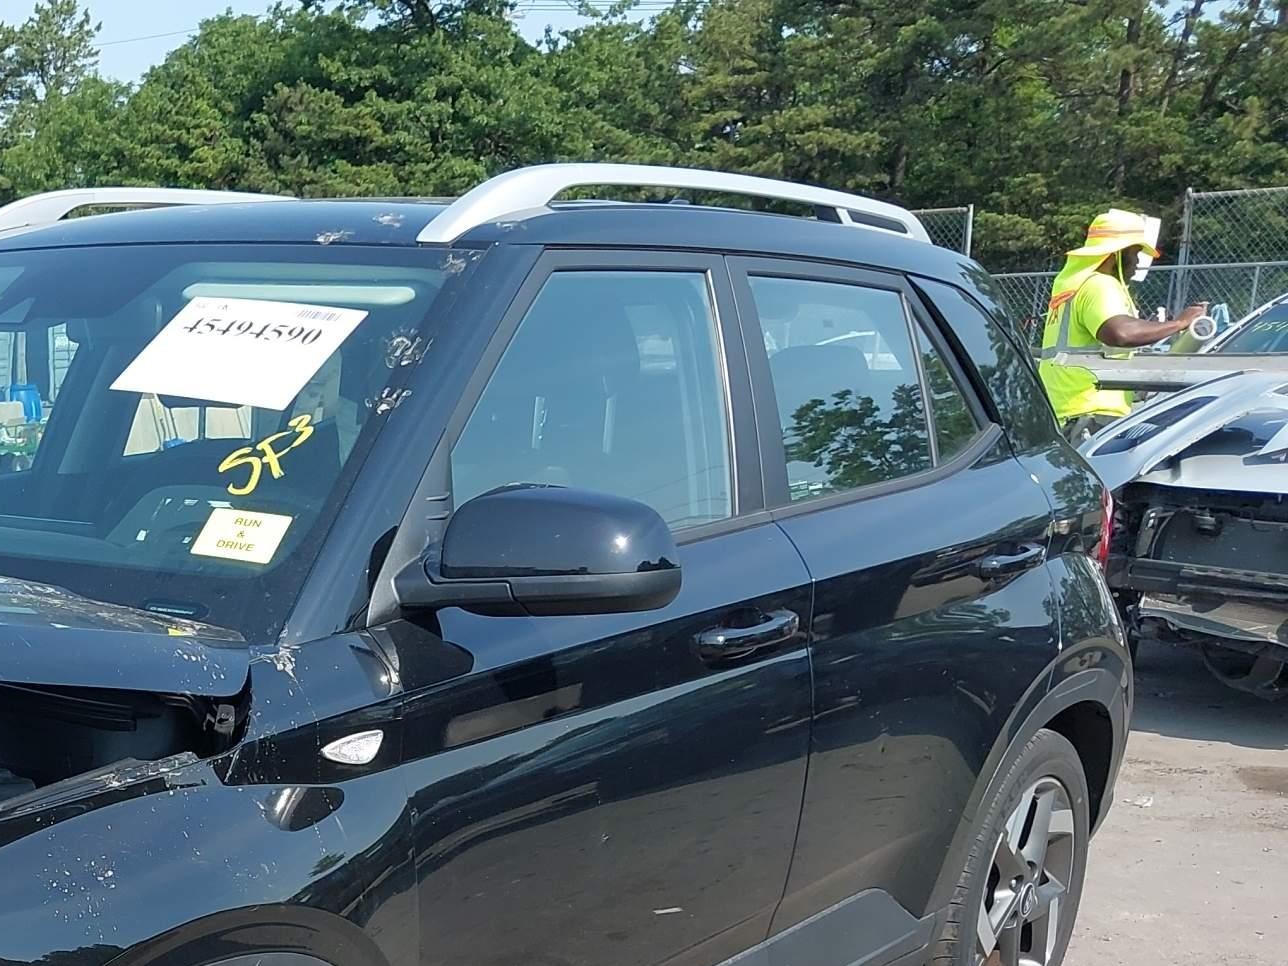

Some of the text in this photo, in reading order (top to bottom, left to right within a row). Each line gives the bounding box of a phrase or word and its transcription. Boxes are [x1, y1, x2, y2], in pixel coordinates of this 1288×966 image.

[184, 317, 322, 345] 45494590
[234, 517, 262, 528] RUN
[237, 530, 245, 538] &
[216, 539, 255, 551] DRIVE
